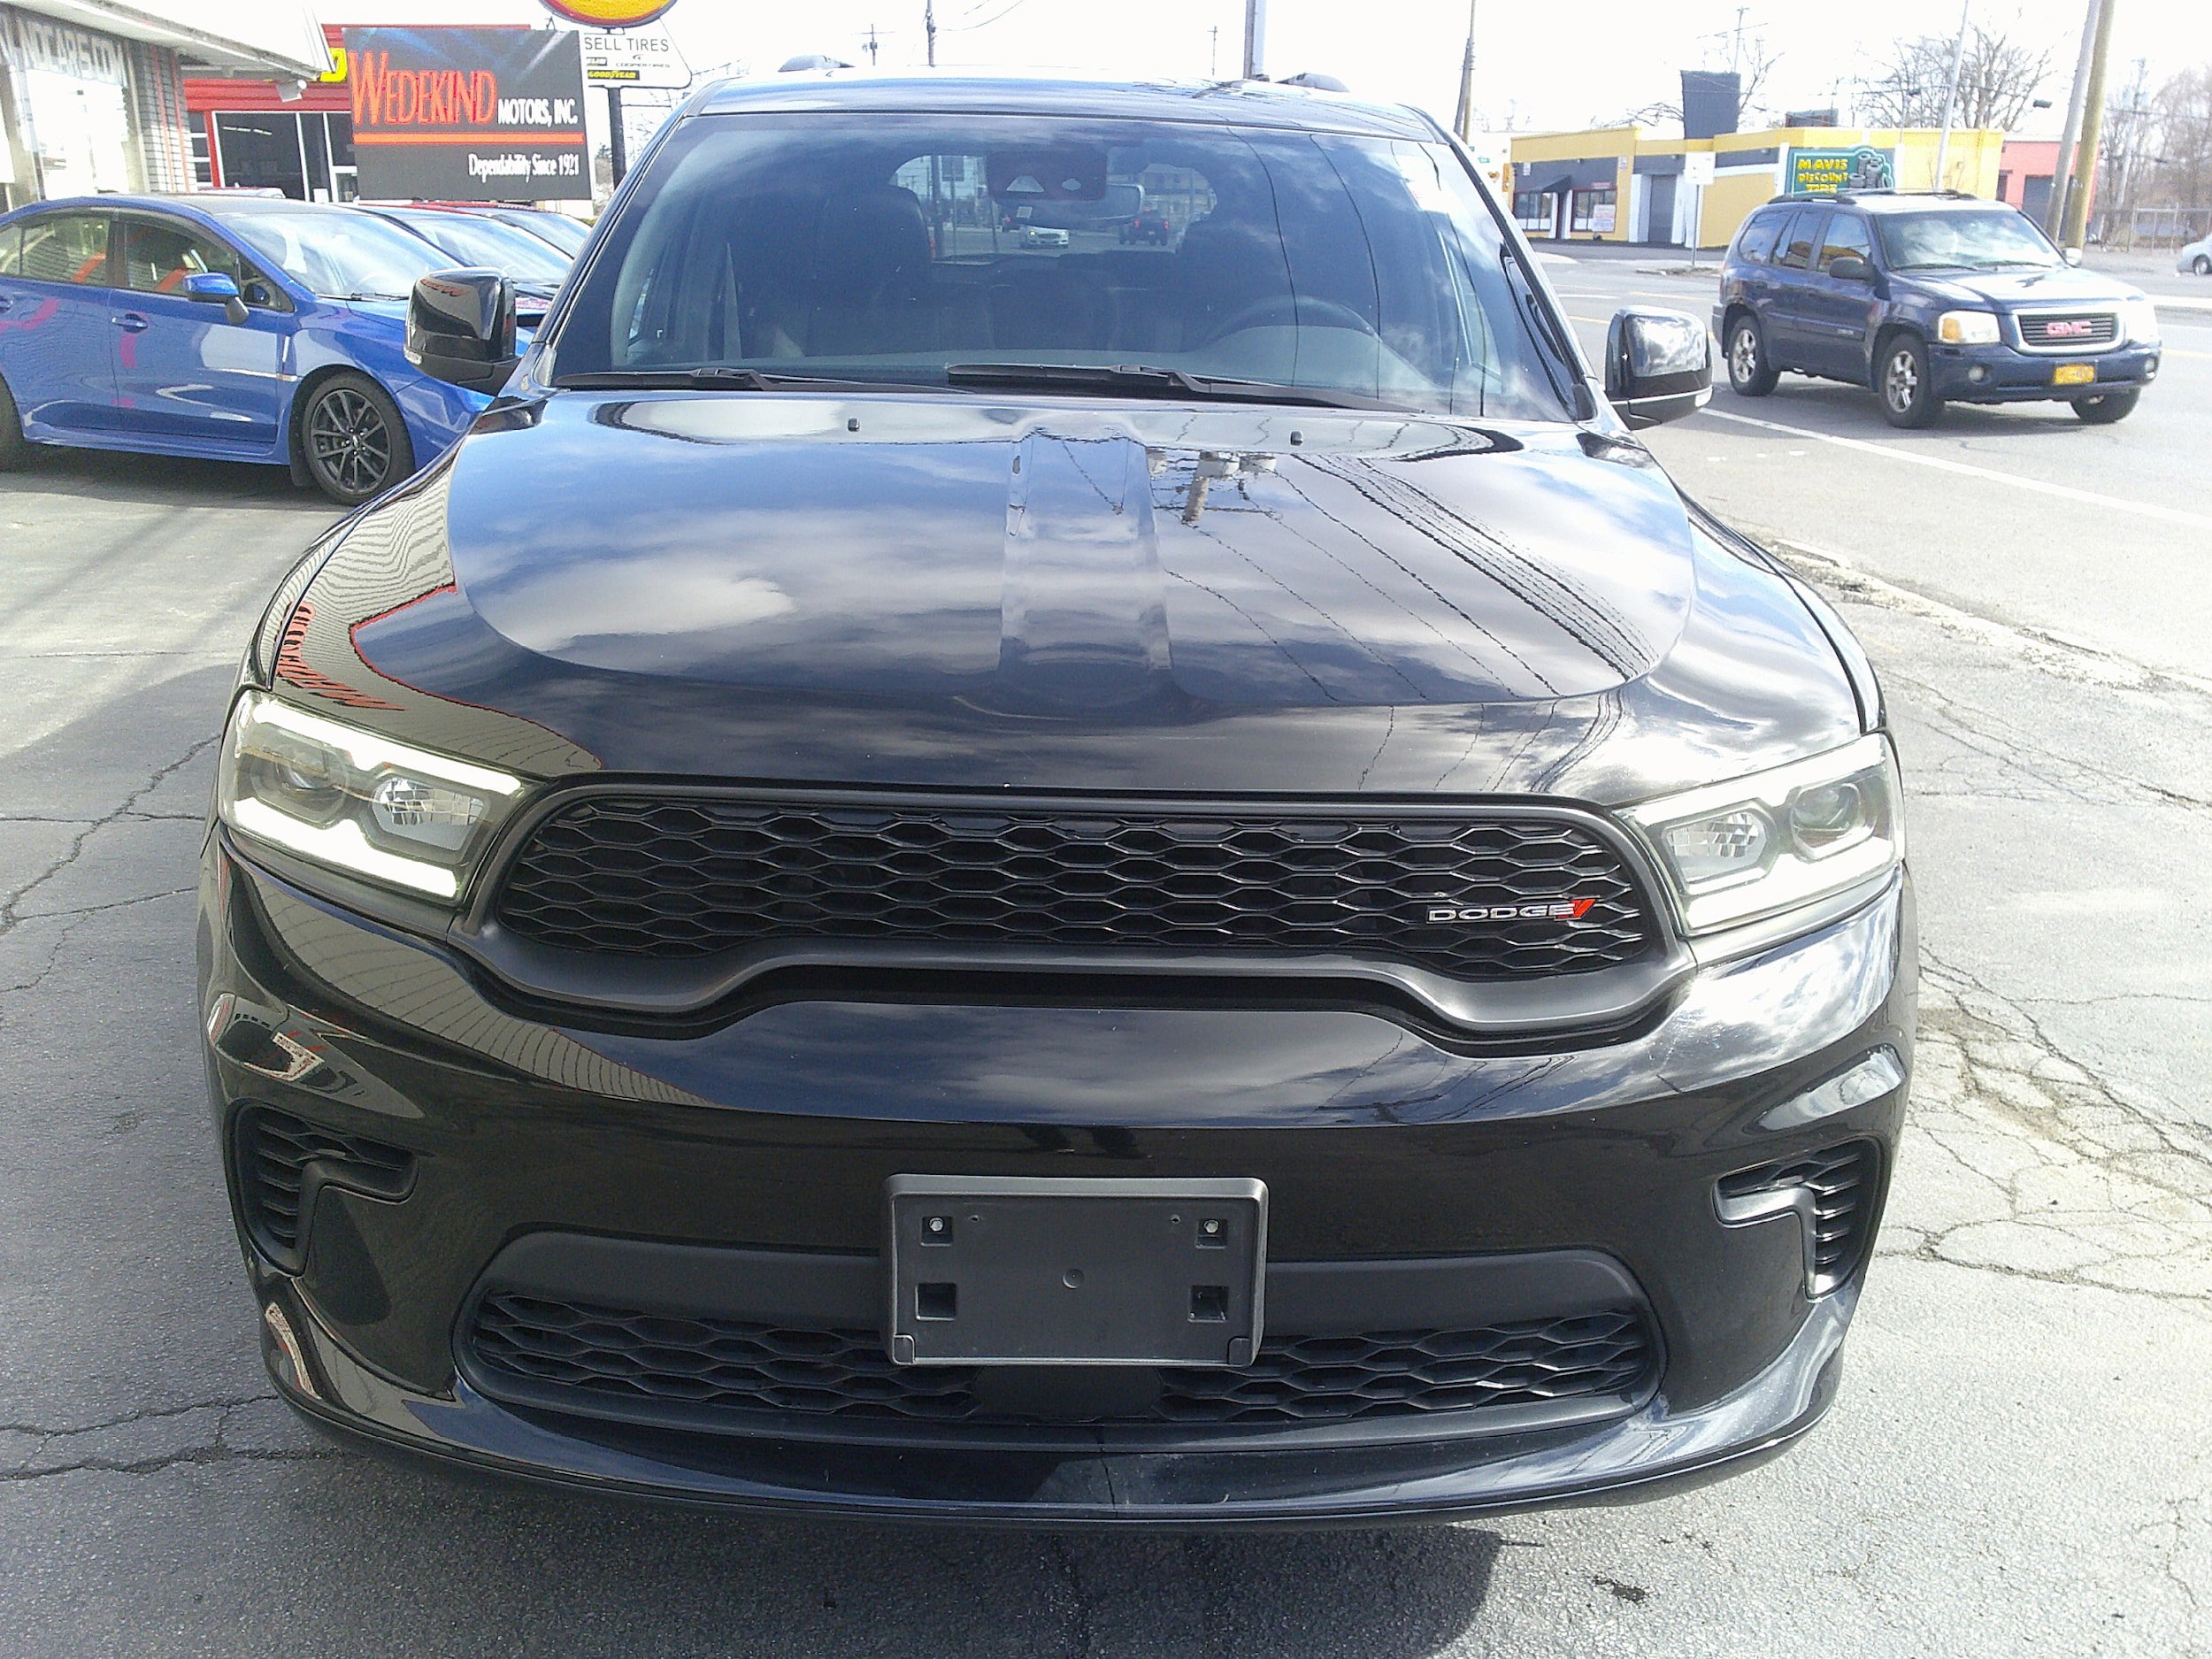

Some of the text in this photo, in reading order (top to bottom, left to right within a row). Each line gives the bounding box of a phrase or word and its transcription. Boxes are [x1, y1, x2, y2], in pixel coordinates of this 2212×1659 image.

[584, 36, 670, 52] SELL TIRES
[348, 50, 497, 126] WEDEKIND
[497, 99, 552, 127] MOTORS,
[554, 98, 579, 125] INC.
[468, 153, 580, 183] Dependability Since 1921
[1797, 159, 1848, 170] MAVIS
[1797, 173, 1848, 182] DISCOUNT
[2047, 320, 2093, 335] GMC
[1428, 902, 1575, 922] DODGE
